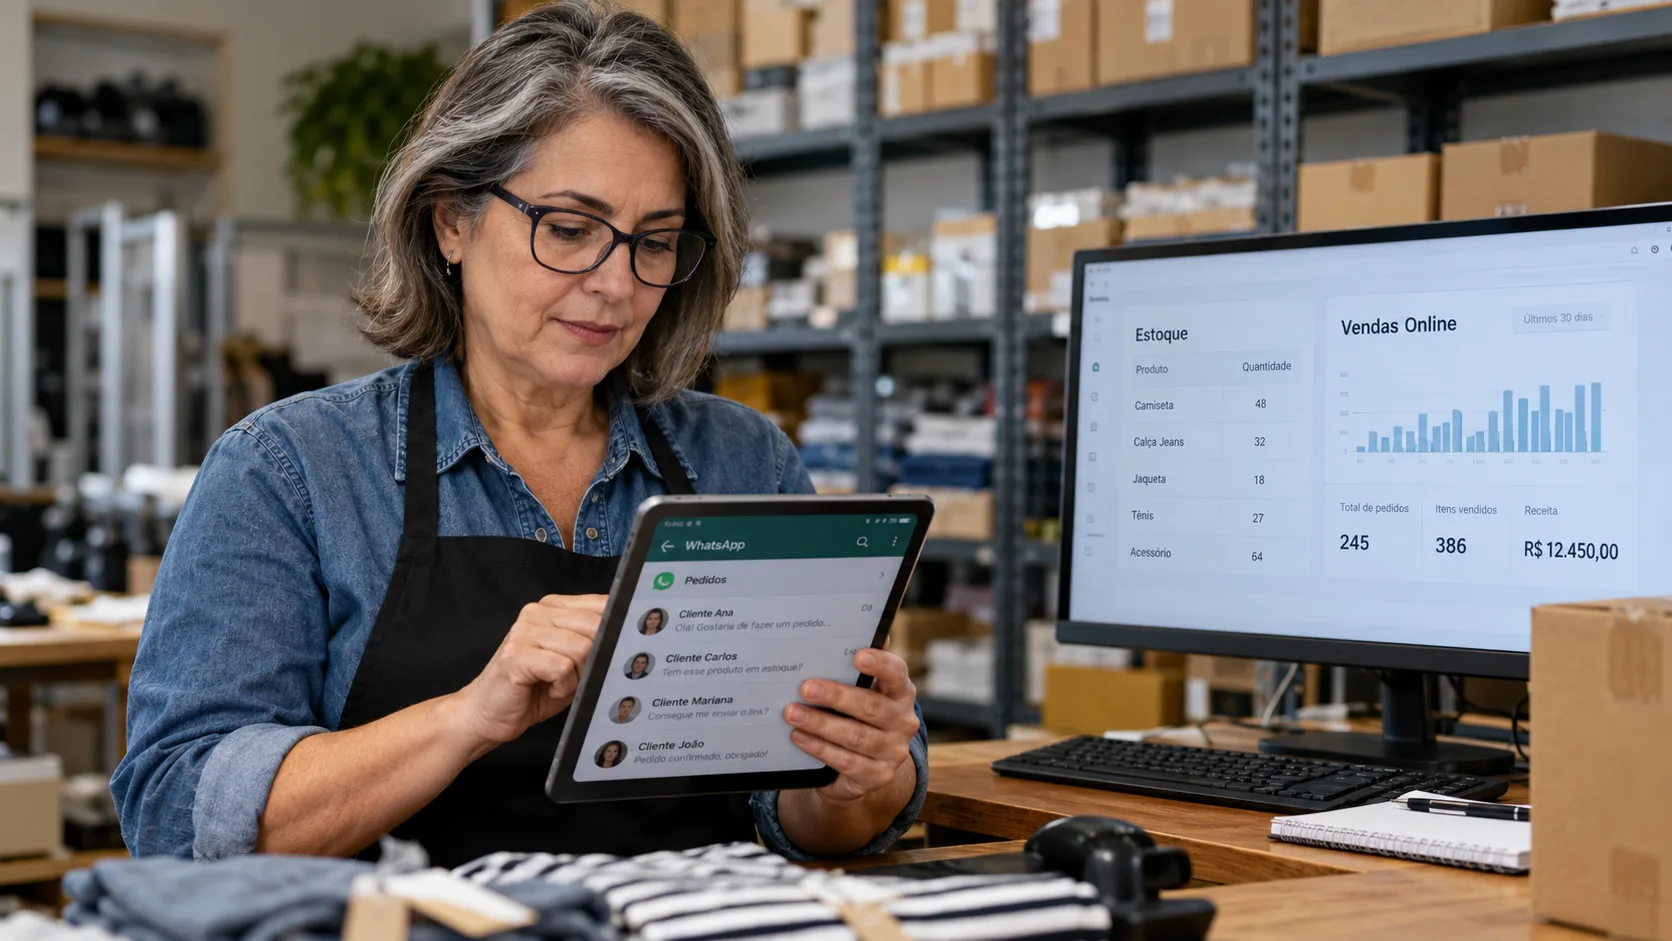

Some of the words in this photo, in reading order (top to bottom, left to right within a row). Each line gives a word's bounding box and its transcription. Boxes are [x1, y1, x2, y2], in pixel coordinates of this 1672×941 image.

[1523, 313, 1558, 324] Últimos
[1560, 313, 1572, 322] 30
[1574, 311, 1593, 321] dias
[1341, 318, 1399, 335] Vendas
[1405, 316, 1457, 332] Online
[1135, 327, 1188, 344] Estoque
[1136, 365, 1168, 375] Produto
[1242, 361, 1292, 372] Quantidade
[1135, 401, 1174, 411] Camiseta
[1255, 399, 1267, 408] 48
[1134, 437, 1157, 447] Calça
[1159, 437, 1184, 447] Jeans
[1254, 437, 1266, 447] 32
[1133, 474, 1166, 485] Jaqueta
[1254, 475, 1265, 485] 18
[1340, 503, 1360, 512] Total
[1362, 503, 1373, 512] de
[1375, 503, 1409, 515] pedidos
[1435, 504, 1456, 514] Itens
[1458, 504, 1497, 515] vendidos
[1524, 506, 1558, 516] Receita
[1252, 514, 1264, 523] 27
[685, 540, 745, 552] WhatsApp
[1340, 534, 1369, 550] 245
[1435, 537, 1466, 554] 386
[1130, 548, 1171, 558] Acessório
[1251, 552, 1263, 561] 64
[1524, 540, 1543, 558] R$
[1547, 541, 1619, 562] 12.450,00
[685, 575, 727, 585] Pedidos
[679, 610, 712, 619] Cliente
[714, 609, 734, 617] Ana
[737, 622, 749, 630] de
[751, 620, 776, 630] fazer
[777, 621, 791, 629] um
[666, 653, 702, 663] Cliente
[704, 651, 737, 661] Carlos
[663, 668, 682, 676] Tem
[683, 667, 703, 675] esse
[705, 665, 743, 676] produto
[761, 663, 803, 674] estoque?
[652, 697, 689, 707] Cliente
[691, 695, 733, 706] Mariana
[648, 711, 693, 722] Consegue
[695, 711, 709, 719] me
[712, 709, 738, 718] enviar
[748, 707, 769, 716] link?
[638, 741, 675, 751] Cliente
[678, 739, 704, 749] João
[634, 754, 666, 764] Pedido
